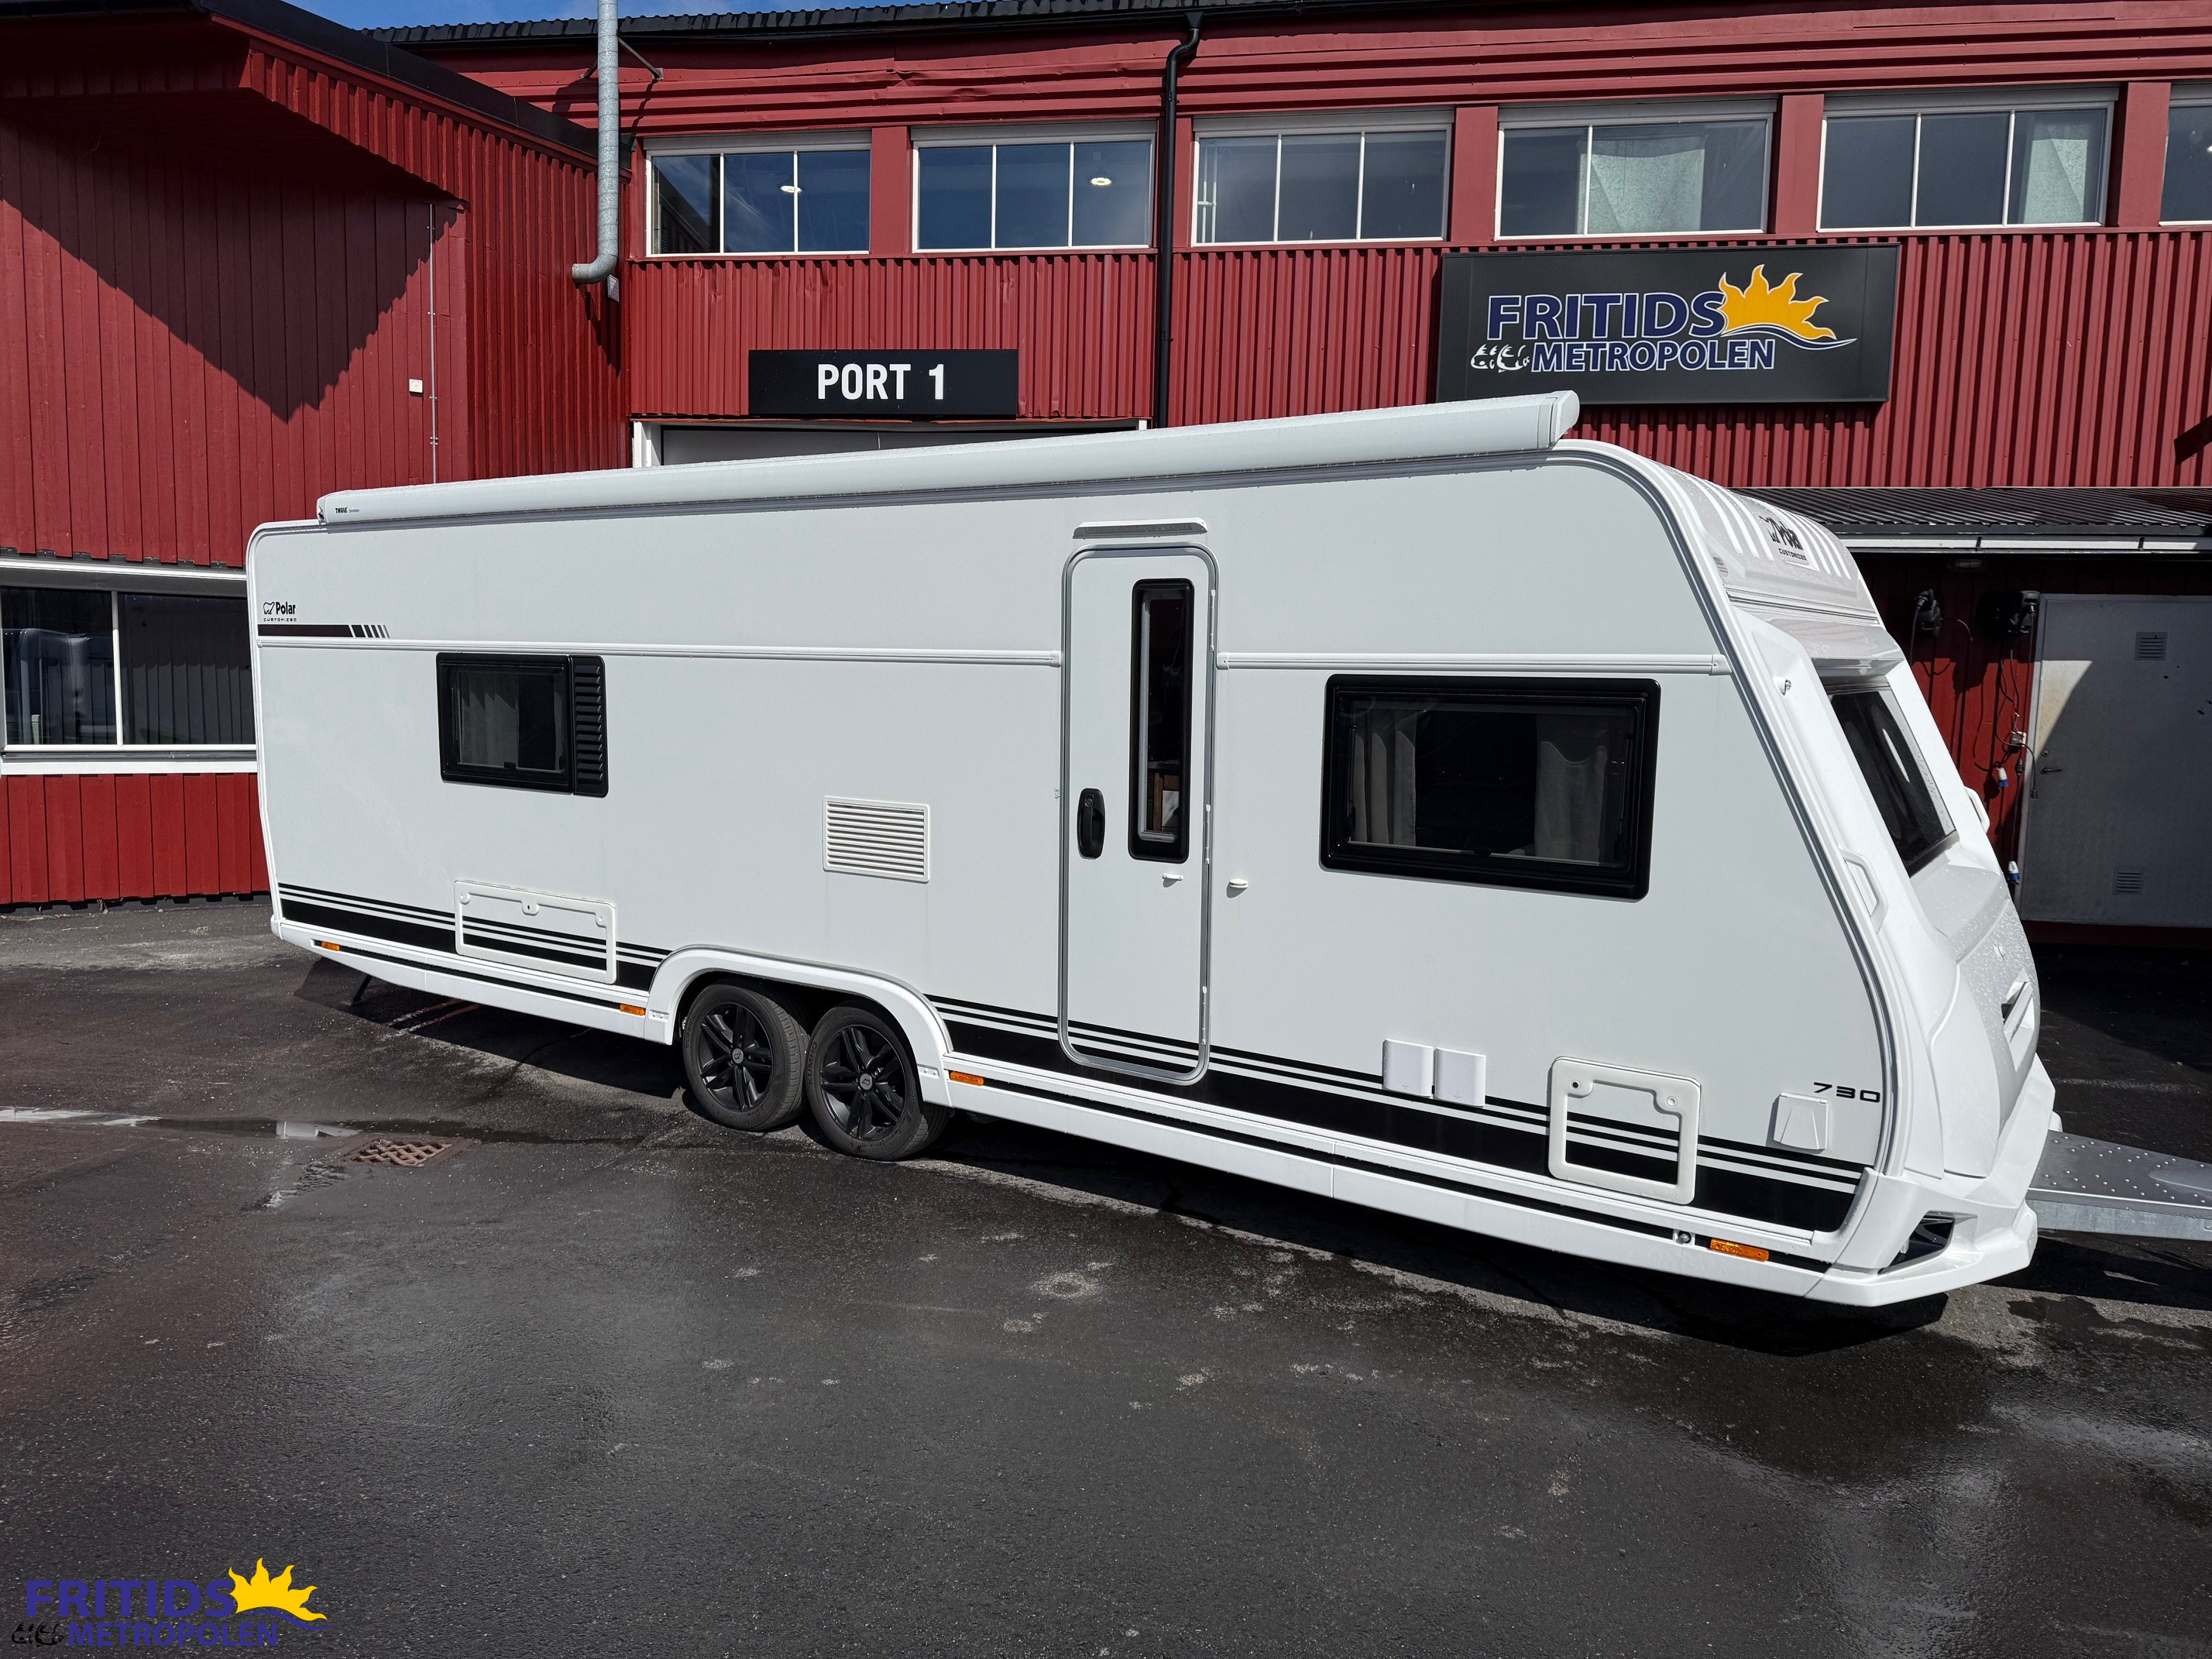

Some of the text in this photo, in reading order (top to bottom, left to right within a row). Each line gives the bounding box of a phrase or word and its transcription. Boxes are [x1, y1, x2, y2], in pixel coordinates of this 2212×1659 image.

[1487, 291, 1727, 340] FRITIDS
[1530, 339, 1776, 373] METROPOLEN
[818, 364, 944, 400] PORT 1
[276, 601, 296, 615] Polar
[1813, 1081, 1881, 1104] 730
